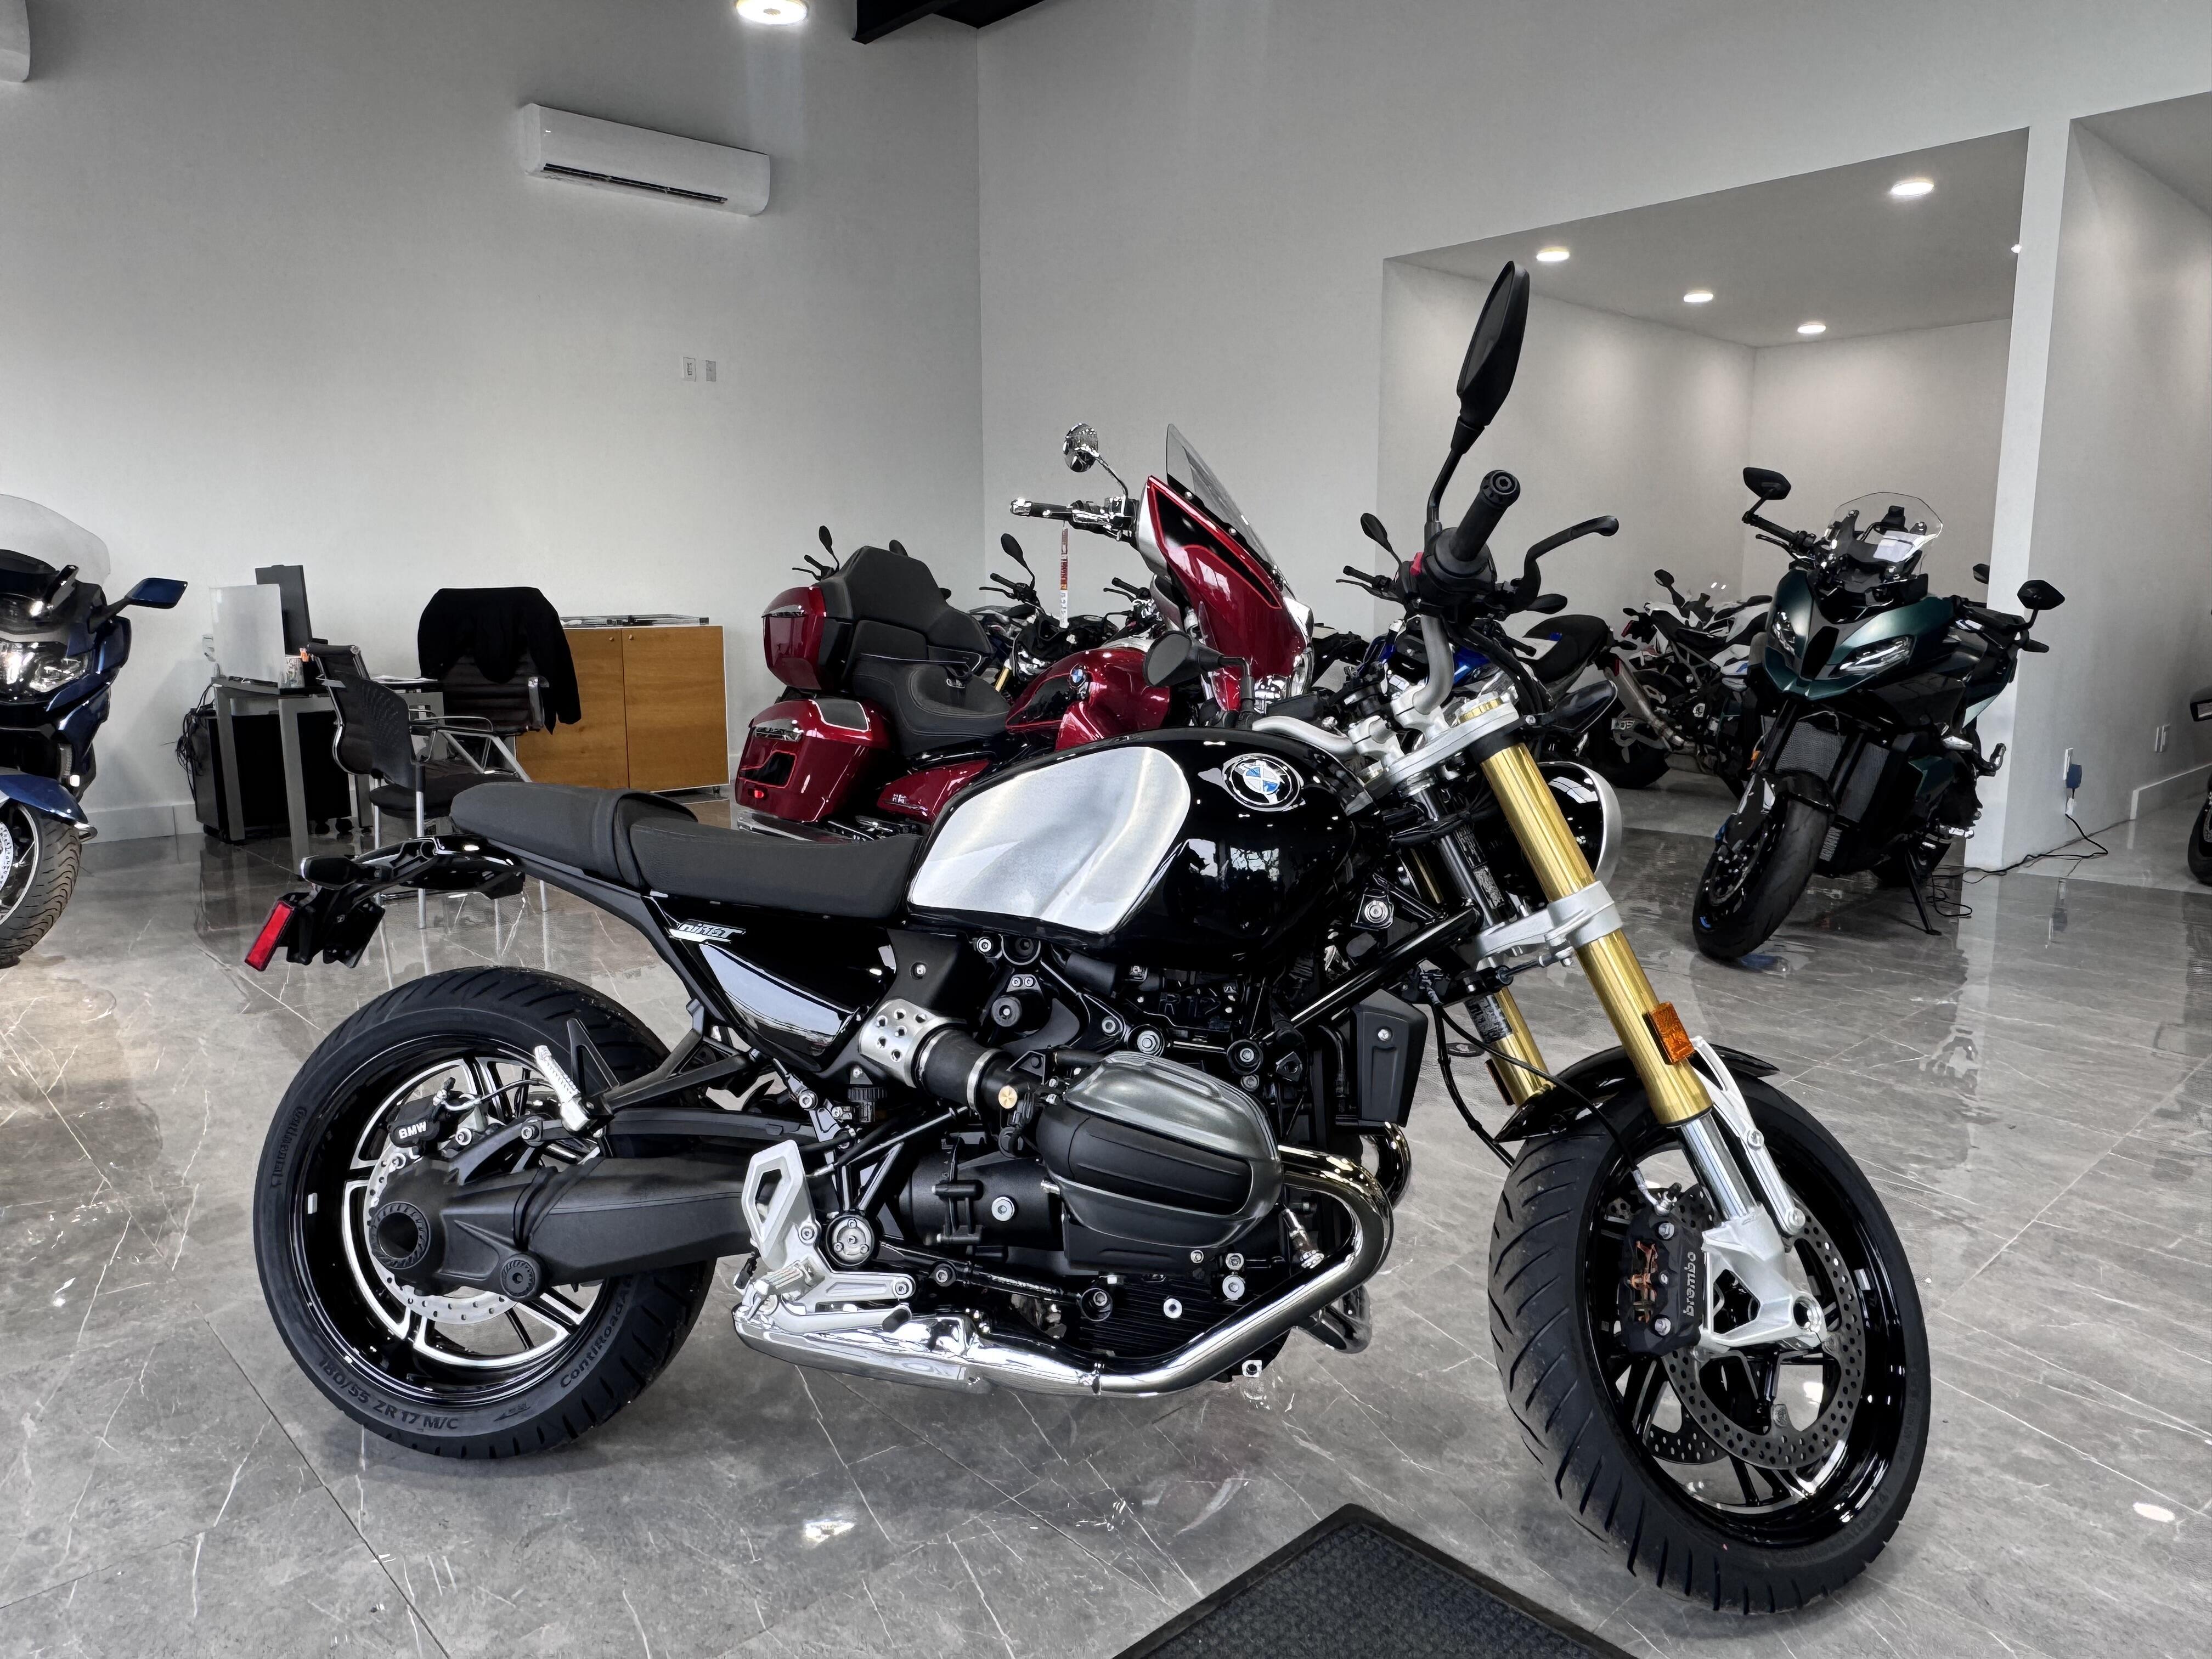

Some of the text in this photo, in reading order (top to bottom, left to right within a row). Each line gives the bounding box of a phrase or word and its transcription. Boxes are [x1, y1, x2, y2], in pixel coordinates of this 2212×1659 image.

[678, 923, 743, 938] nineT
[274, 1106, 308, 1180] Continental
[398, 1121, 426, 1139] BMW
[1683, 1251, 1696, 1317] brembo
[319, 1357, 371, 1403] 180/55
[423, 1416, 459, 1430] M/C
